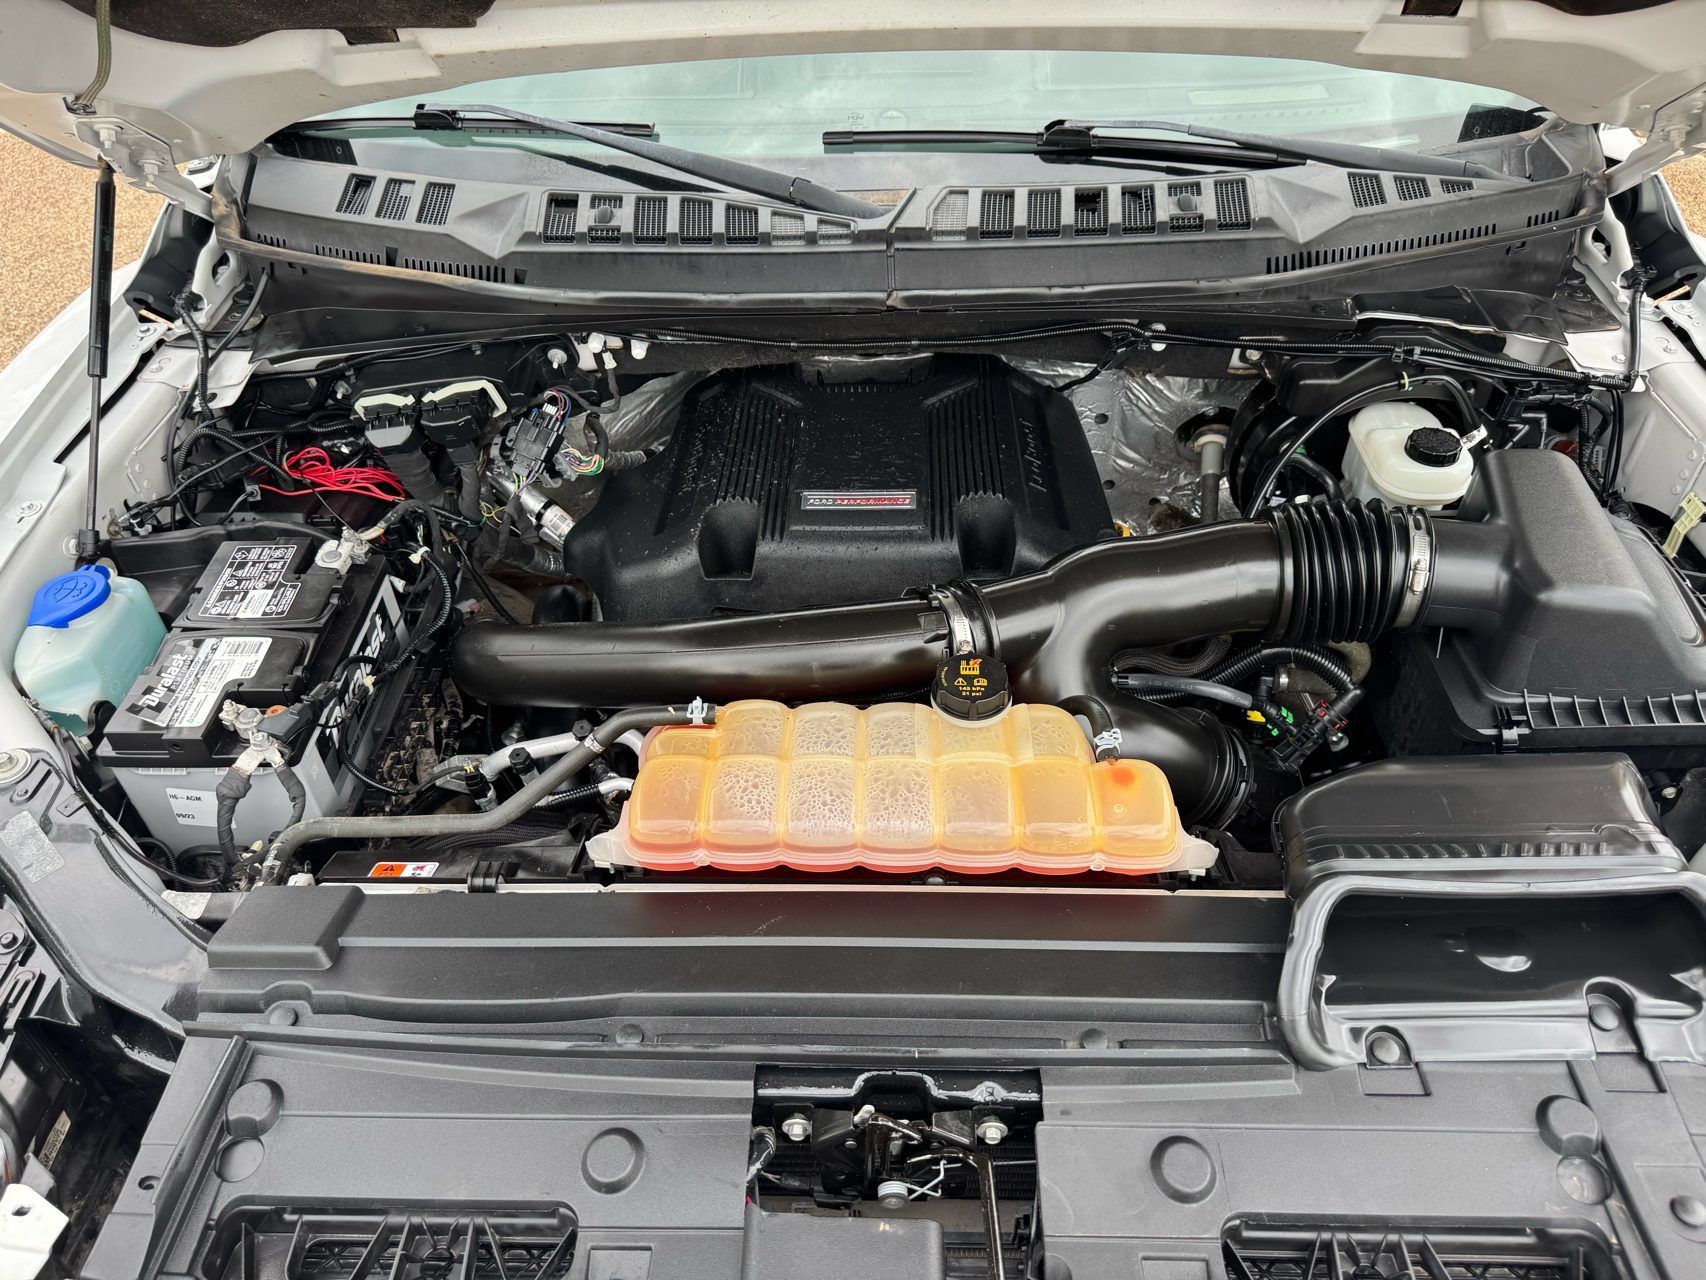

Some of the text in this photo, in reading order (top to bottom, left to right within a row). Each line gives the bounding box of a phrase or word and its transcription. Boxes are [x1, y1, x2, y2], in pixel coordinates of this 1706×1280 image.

[138, 652, 188, 707] Duralast
[171, 654, 194, 690] PLATINUM
[178, 656, 202, 697] TECHNOLOGY
